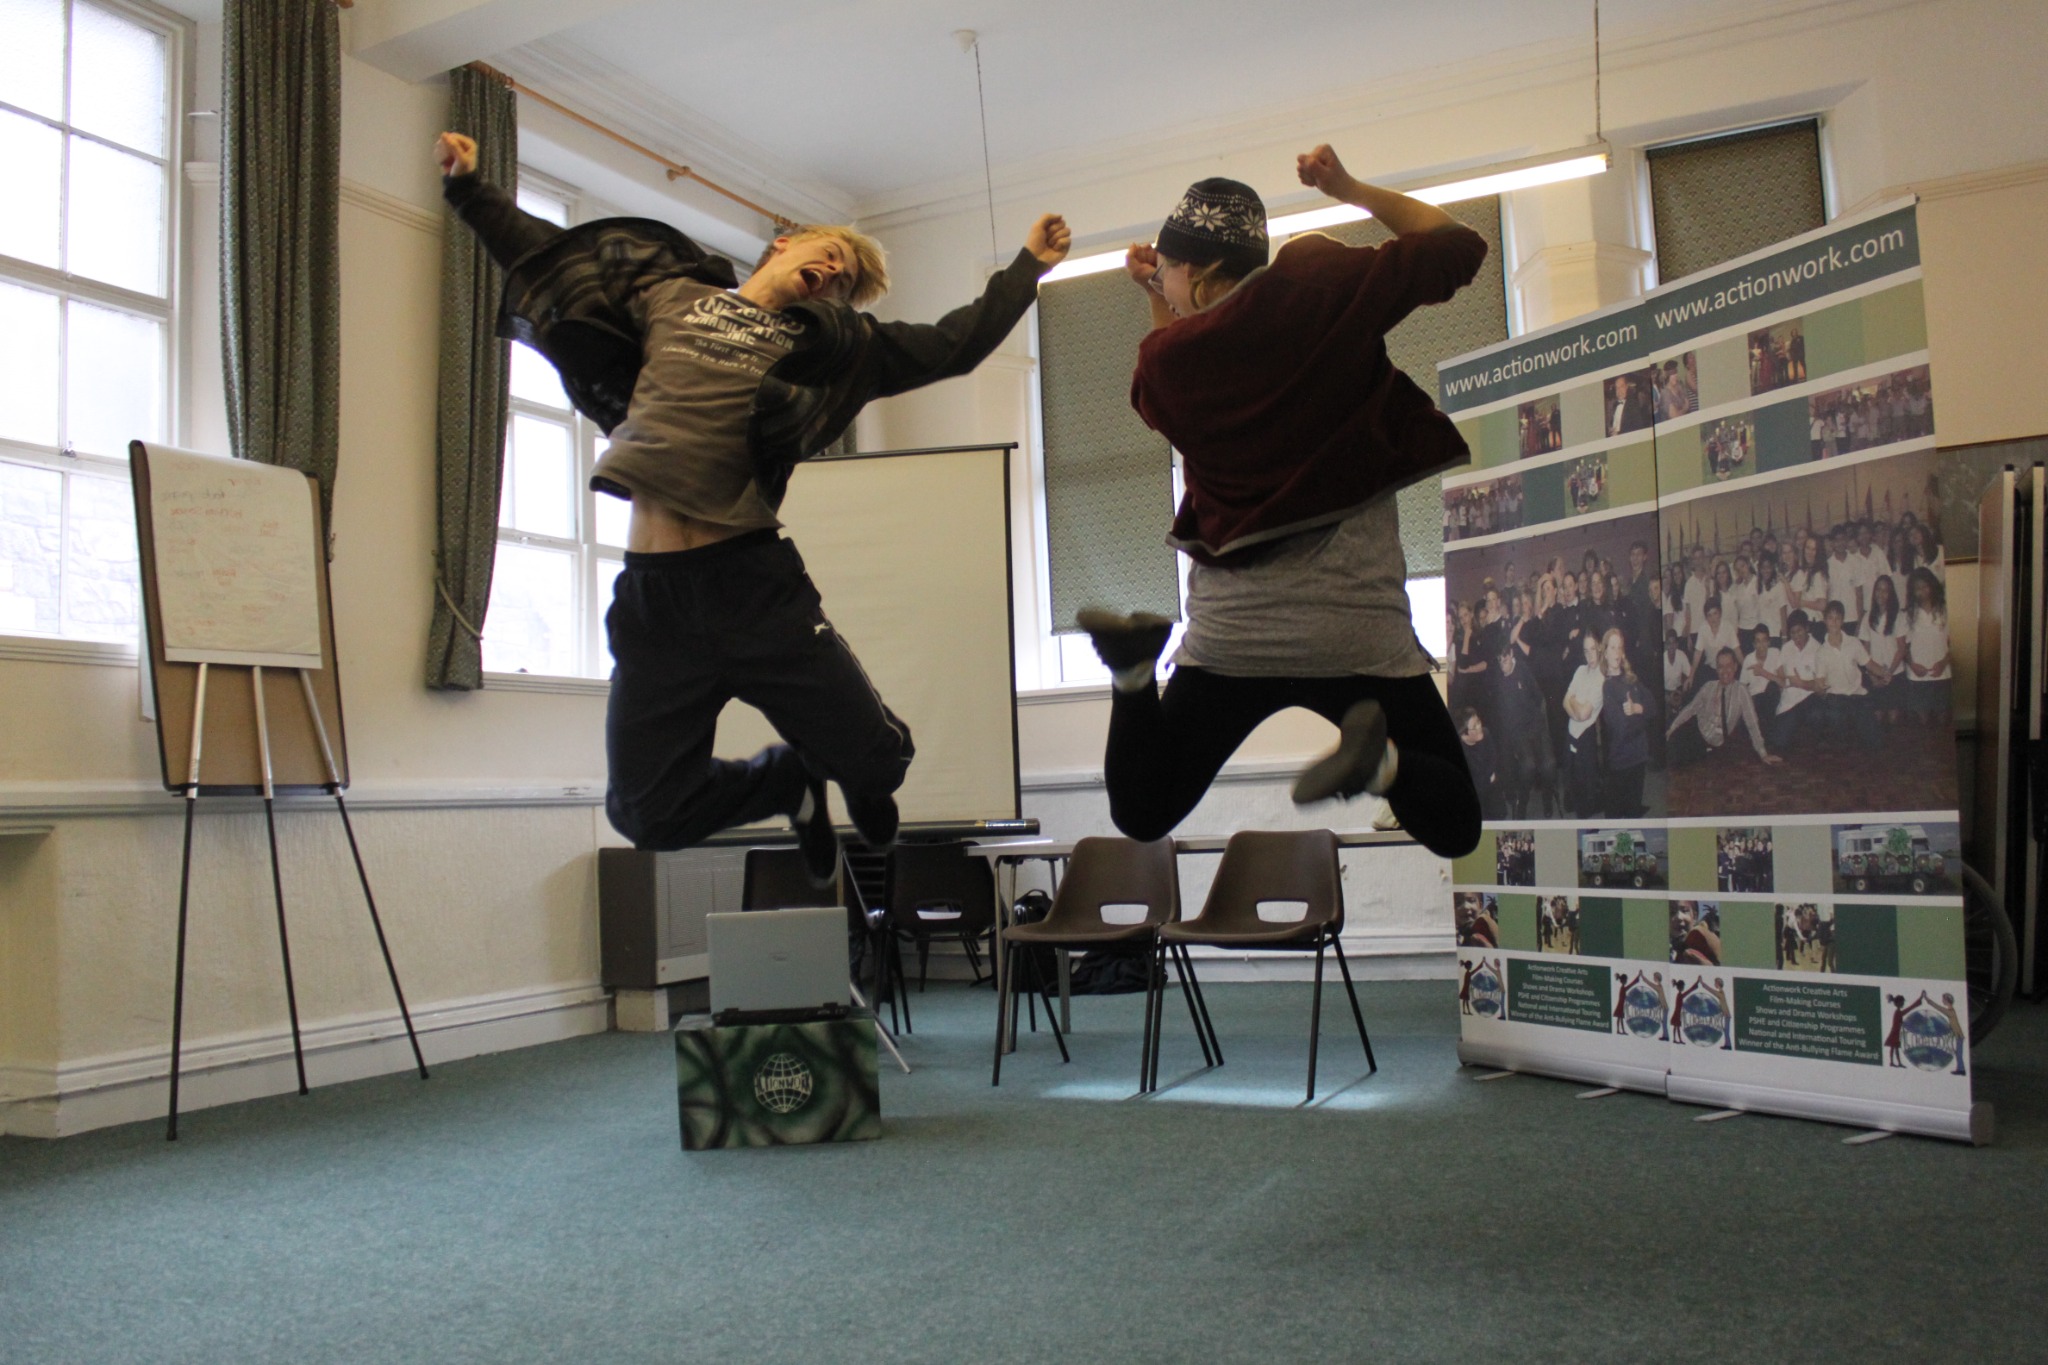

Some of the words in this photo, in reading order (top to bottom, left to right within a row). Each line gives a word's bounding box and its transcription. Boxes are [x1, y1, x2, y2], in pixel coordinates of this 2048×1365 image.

[1654, 228, 1904, 329] www.actionwork.com
[704, 297, 798, 330] Niend
[1445, 324, 1637, 397] www.actionwork.com
[1763, 984, 1801, 994] Actionwork
[1802, 987, 1831, 996] Creative
[1833, 988, 1847, 997] Arts
[1770, 995, 1812, 1008] Film-Making
[1813, 999, 1840, 1008] Courses
[1756, 1006, 1777, 1015] Shows
[1778, 1008, 1791, 1016] and
[1793, 1009, 1815, 1018] Drama
[1817, 1011, 1857, 1022] Workshops
[1749, 1016, 1766, 1025] PSHE
[1768, 1018, 1780, 1026] and
[1782, 1019, 1818, 1030] Citizenship
[1821, 1022, 1865, 1034] Programmes
[1749, 1028, 1776, 1038] National
[1778, 1030, 1791, 1039] and
[1793, 1031, 1837, 1043] International
[1840, 1036, 1866, 1048] Touring
[1738, 1038, 1762, 1048] Winner
[1764, 1040, 1771, 1048] of
[1773, 1041, 1784, 1050] the
[1786, 1042, 1830, 1056] Anti-Bullying
[1831, 1047, 1853, 1057] Flame
[1854, 1050, 1878, 1059] Award
